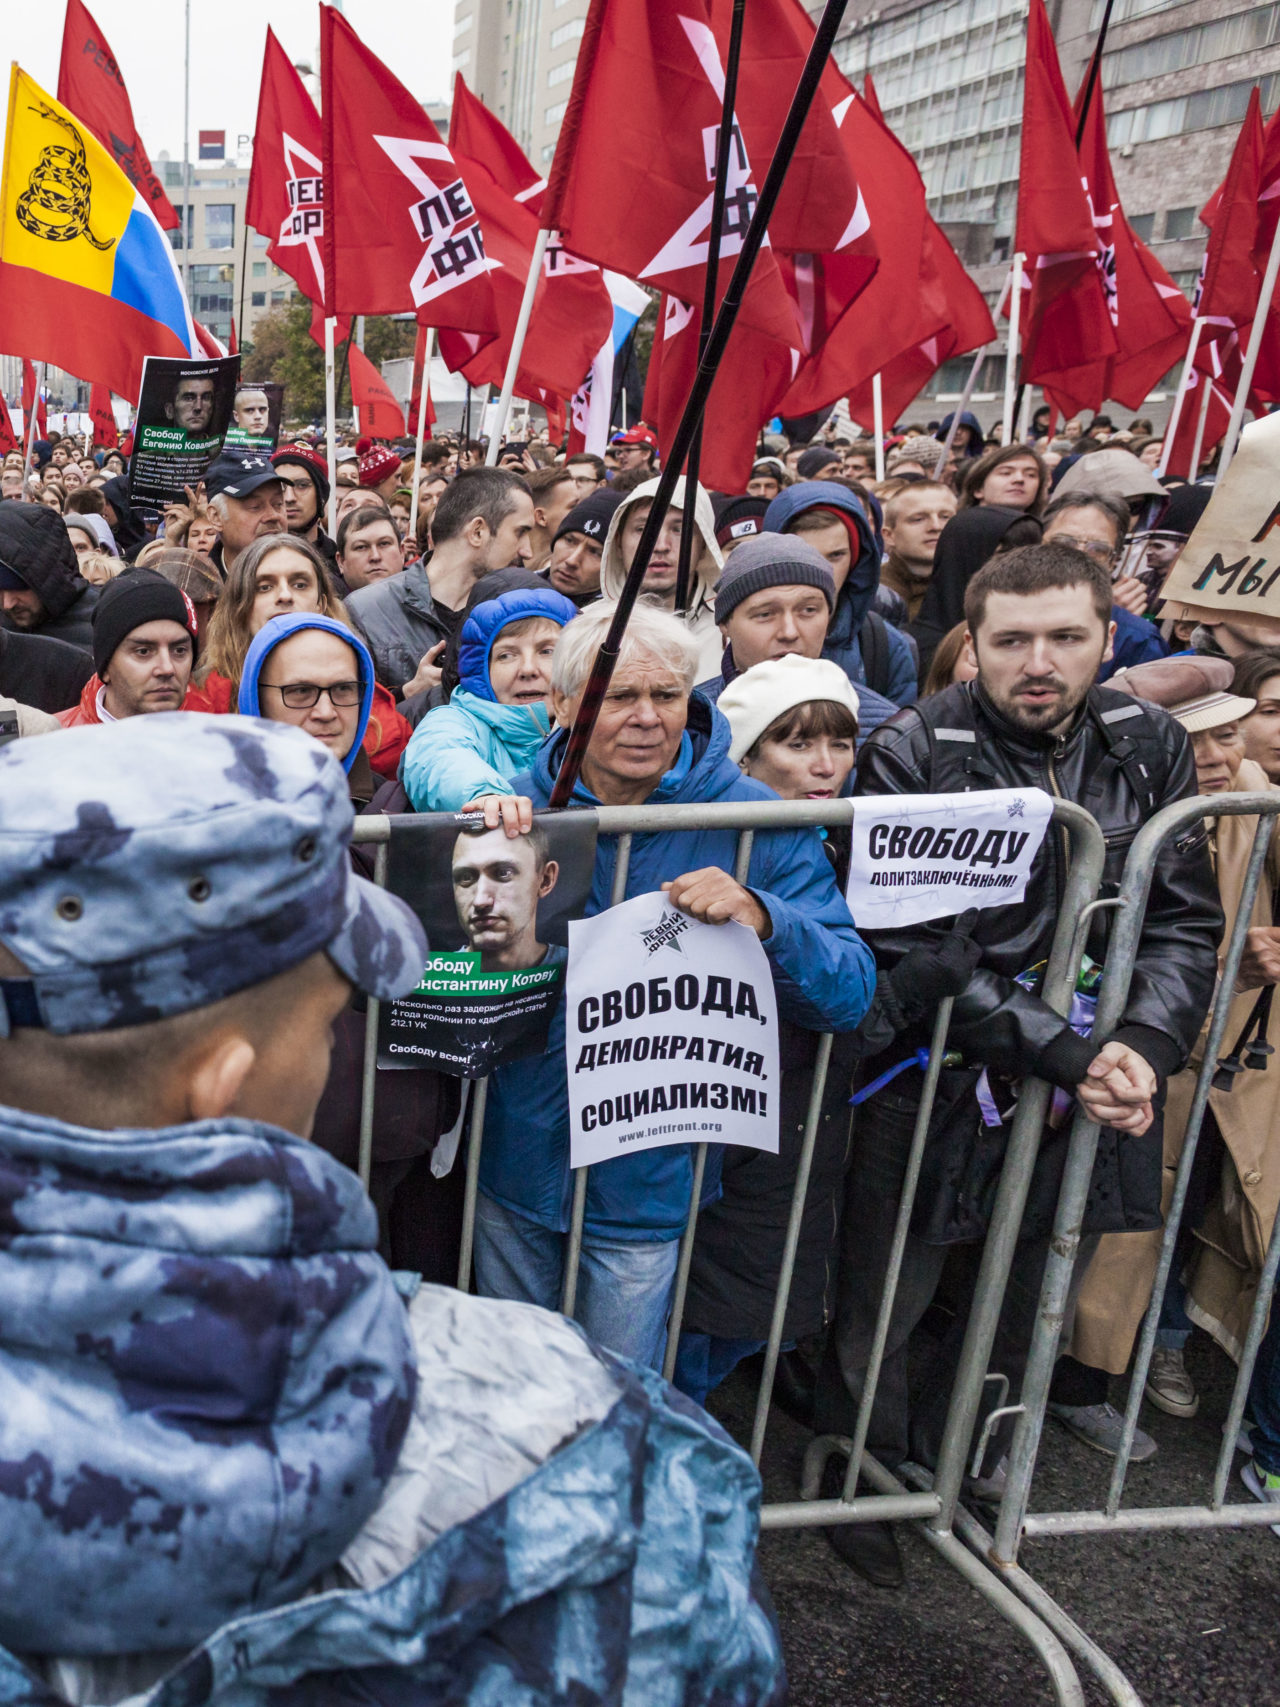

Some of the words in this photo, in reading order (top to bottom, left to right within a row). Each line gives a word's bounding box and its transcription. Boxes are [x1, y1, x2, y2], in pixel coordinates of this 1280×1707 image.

[142, 438, 182, 450] Евгению
[144, 428, 184, 441] Свободу
[869, 824, 1030, 868] СВОБОДУ
[870, 869, 1018, 888] ПОЛИТЗАКЛЮЧЁННЫМ!
[643, 912, 683, 946] ЛЕВЫЙ
[649, 921, 688, 952] ФРОНТ
[425, 958, 475, 975] ободу
[414, 979, 509, 993] нстантину
[511, 968, 557, 988] Котову
[391, 1008, 397, 1016] 4
[400, 1010, 420, 1019] года
[423, 1013, 462, 1024] колонии
[525, 1002, 547, 1013] статье
[392, 999, 442, 1011] Несколько
[463, 1003, 504, 1014] задержан
[577, 974, 767, 1034] СВОБОДА,
[391, 1019, 412, 1028] 212.1
[414, 1021, 427, 1029] УК
[389, 1043, 437, 1059] Свободу
[439, 1050, 471, 1064] всем!
[575, 1035, 768, 1081] ДЕМОКРАТИЯ,
[581, 1082, 768, 1132] СОЦИАЛИЗМ!
[618, 1122, 723, 1144] www.leftfront.org
